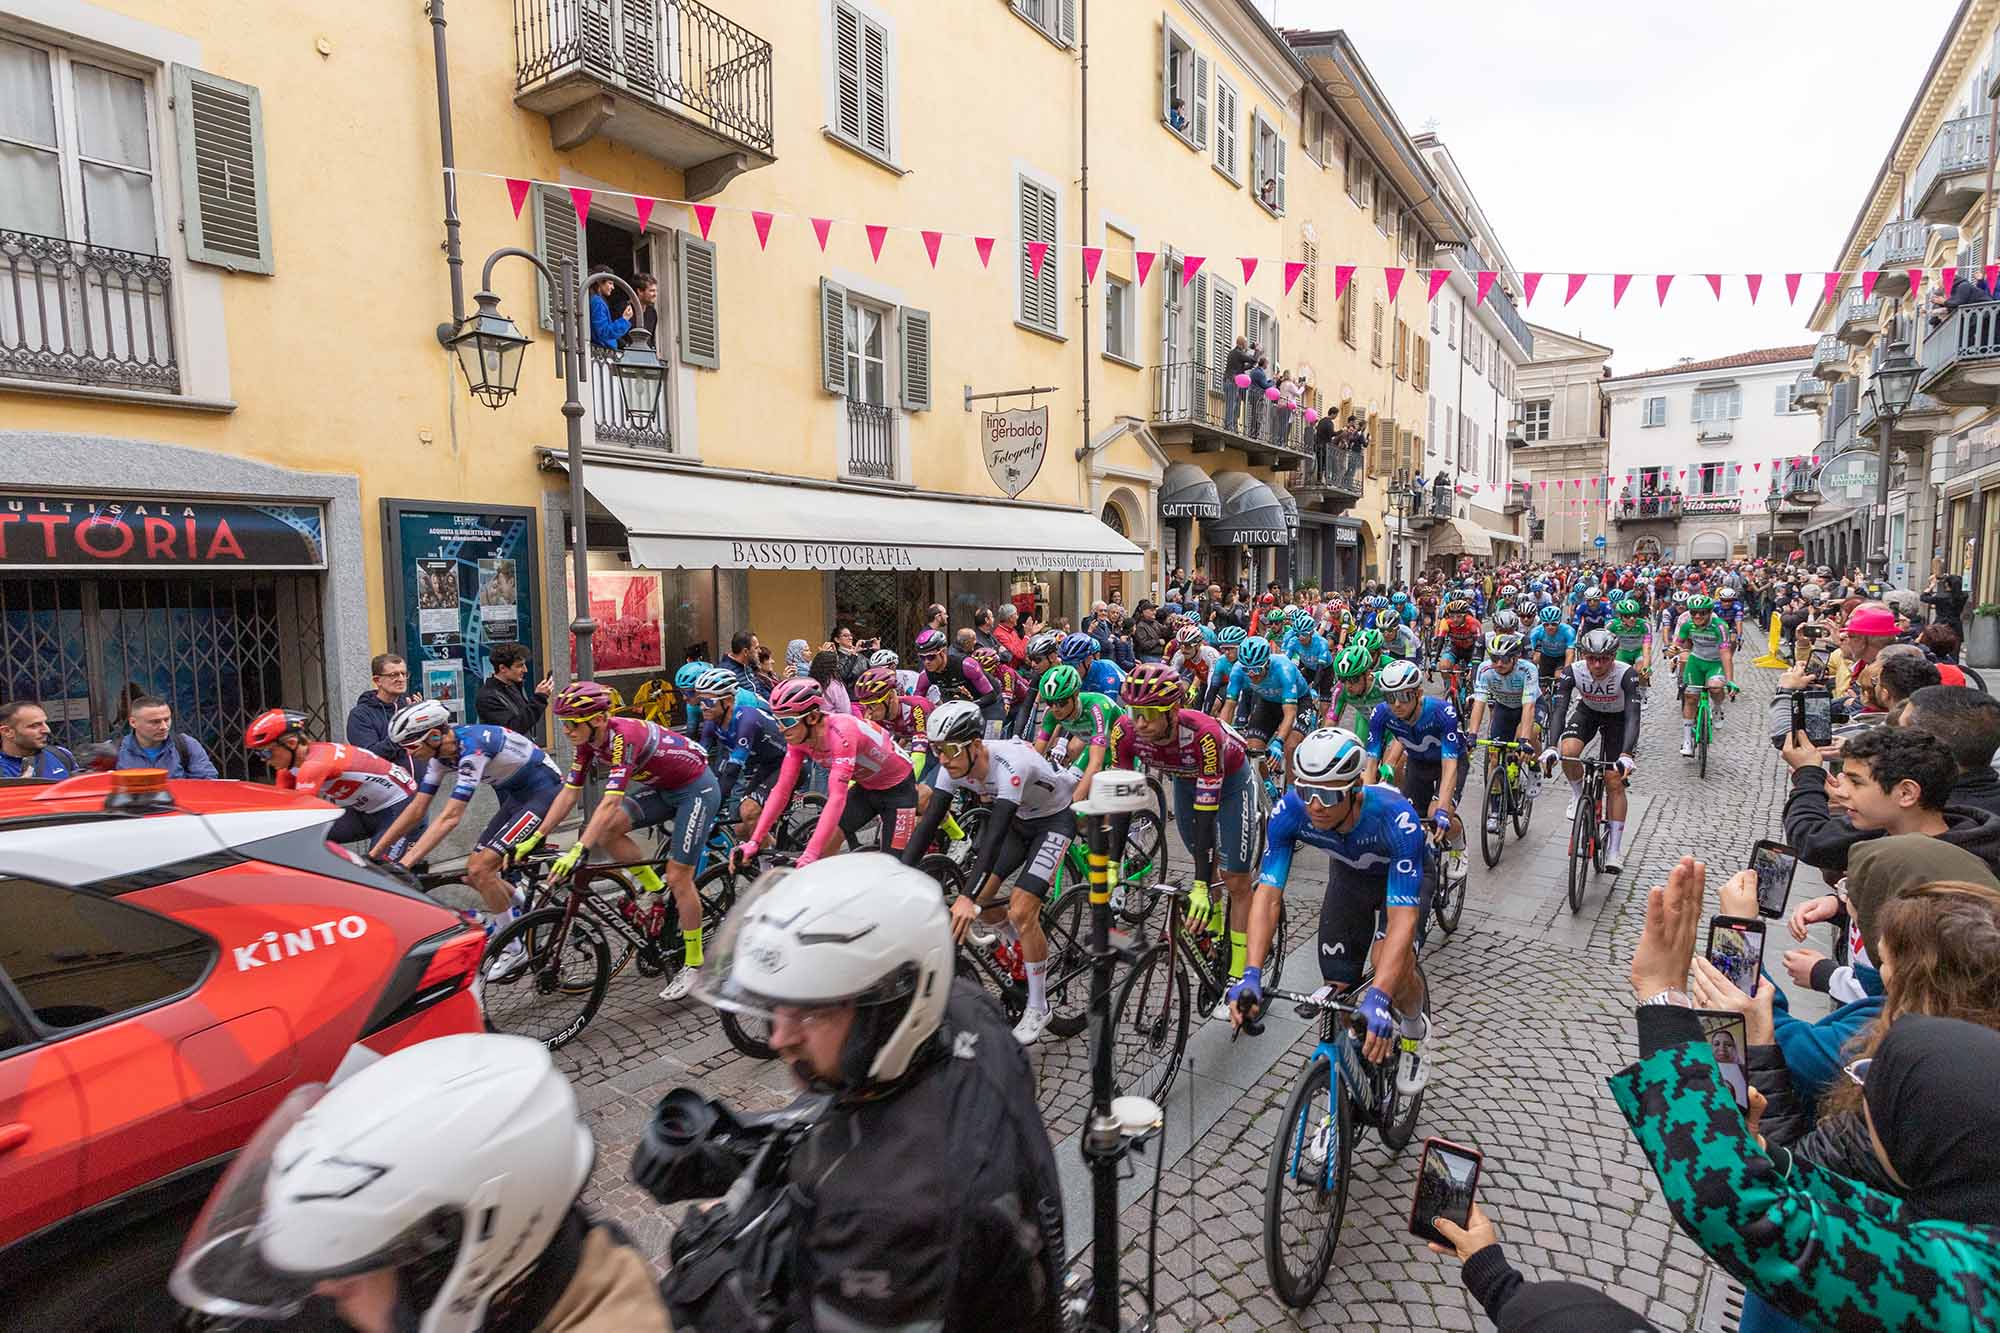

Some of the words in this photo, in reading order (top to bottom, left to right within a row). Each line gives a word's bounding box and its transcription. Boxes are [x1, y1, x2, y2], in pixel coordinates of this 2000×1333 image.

[991, 421, 1042, 442] gerbaldo
[1232, 530, 1269, 543] ANTICO
[438, 546, 443, 560] 1
[496, 547, 503, 559] 2
[732, 542, 797, 563] BASSO
[804, 544, 912, 566] FOTOGRAFIA
[1016, 552, 1113, 568] www.bassofotografia.it
[441, 647, 449, 659] 3
[1582, 683, 1616, 695] UAE
[364, 775, 393, 789] TREK
[1034, 836, 1067, 871] UAE
[587, 895, 649, 948] corratec
[977, 945, 1014, 987] OLNAGO
